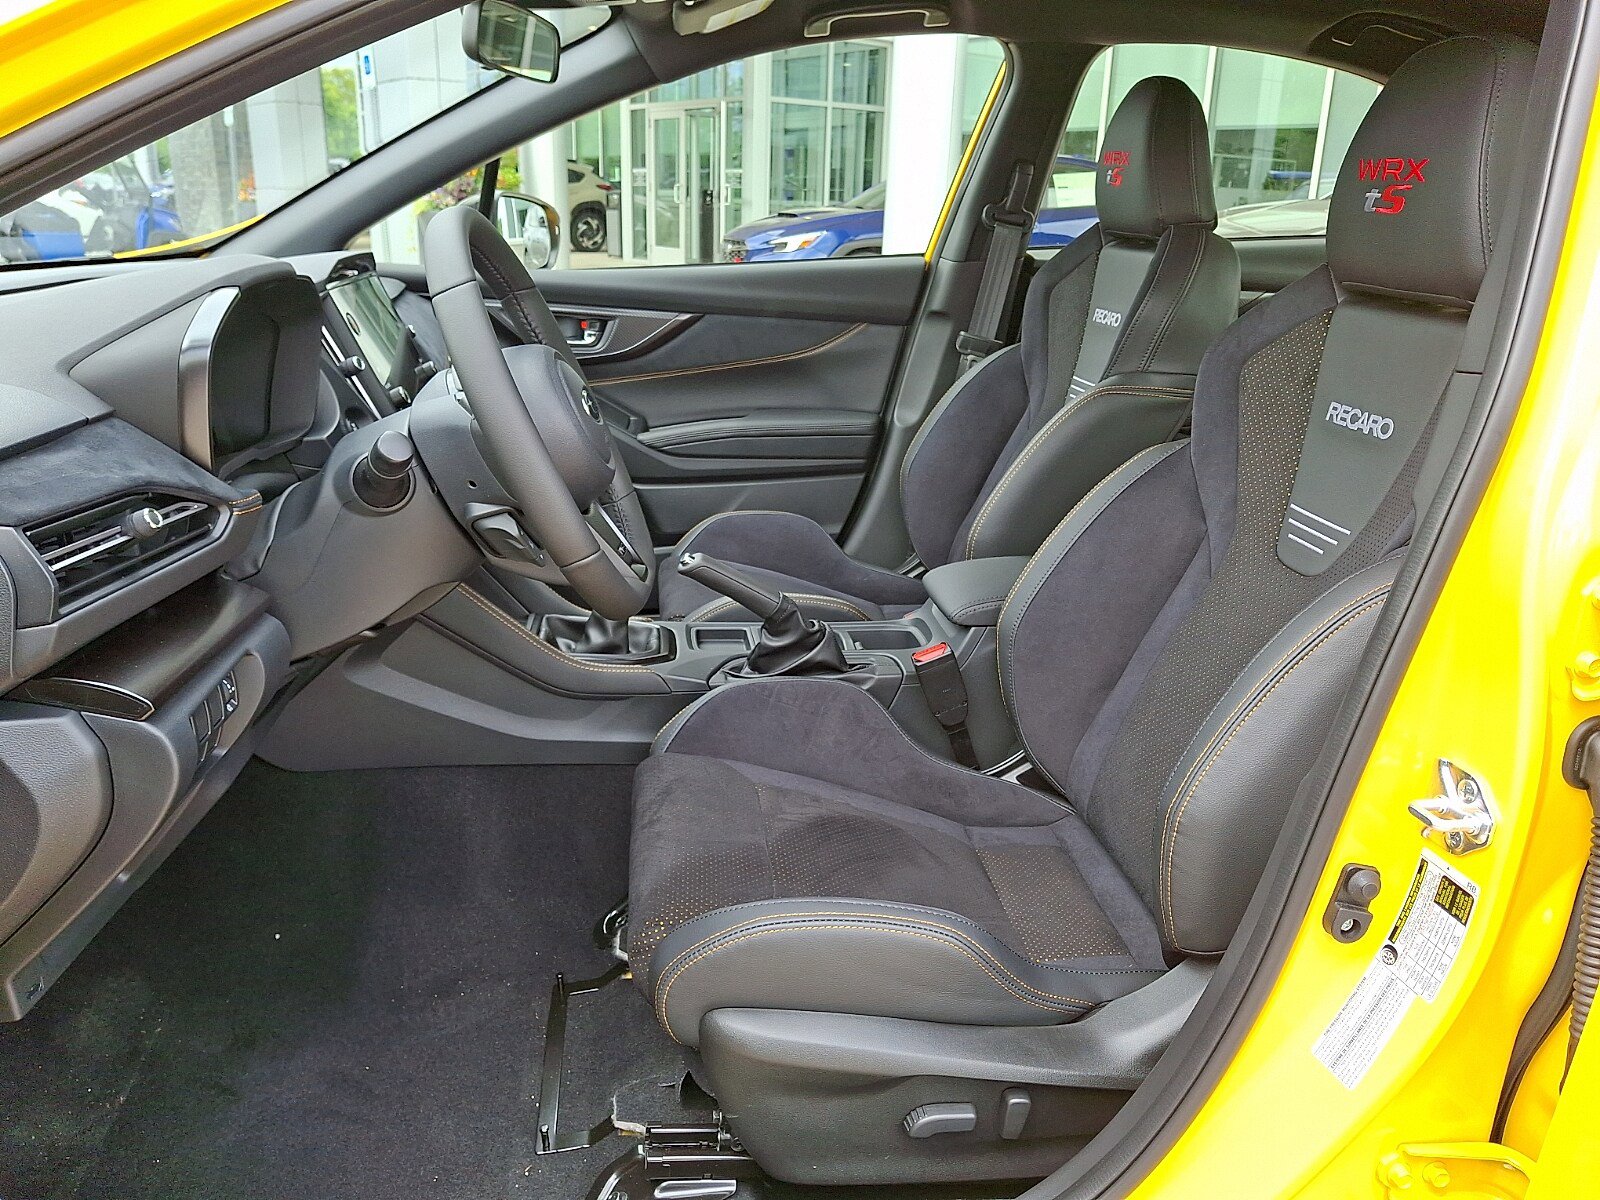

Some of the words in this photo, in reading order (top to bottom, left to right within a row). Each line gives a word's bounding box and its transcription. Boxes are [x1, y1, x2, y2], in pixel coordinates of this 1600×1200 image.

[1103, 151, 1132, 166] WRX
[1358, 157, 1430, 182] WRX
[1106, 167, 1124, 187] tS
[1363, 184, 1413, 214] tS
[1092, 308, 1121, 327] RECARO
[1325, 401, 1395, 440] RECARO
